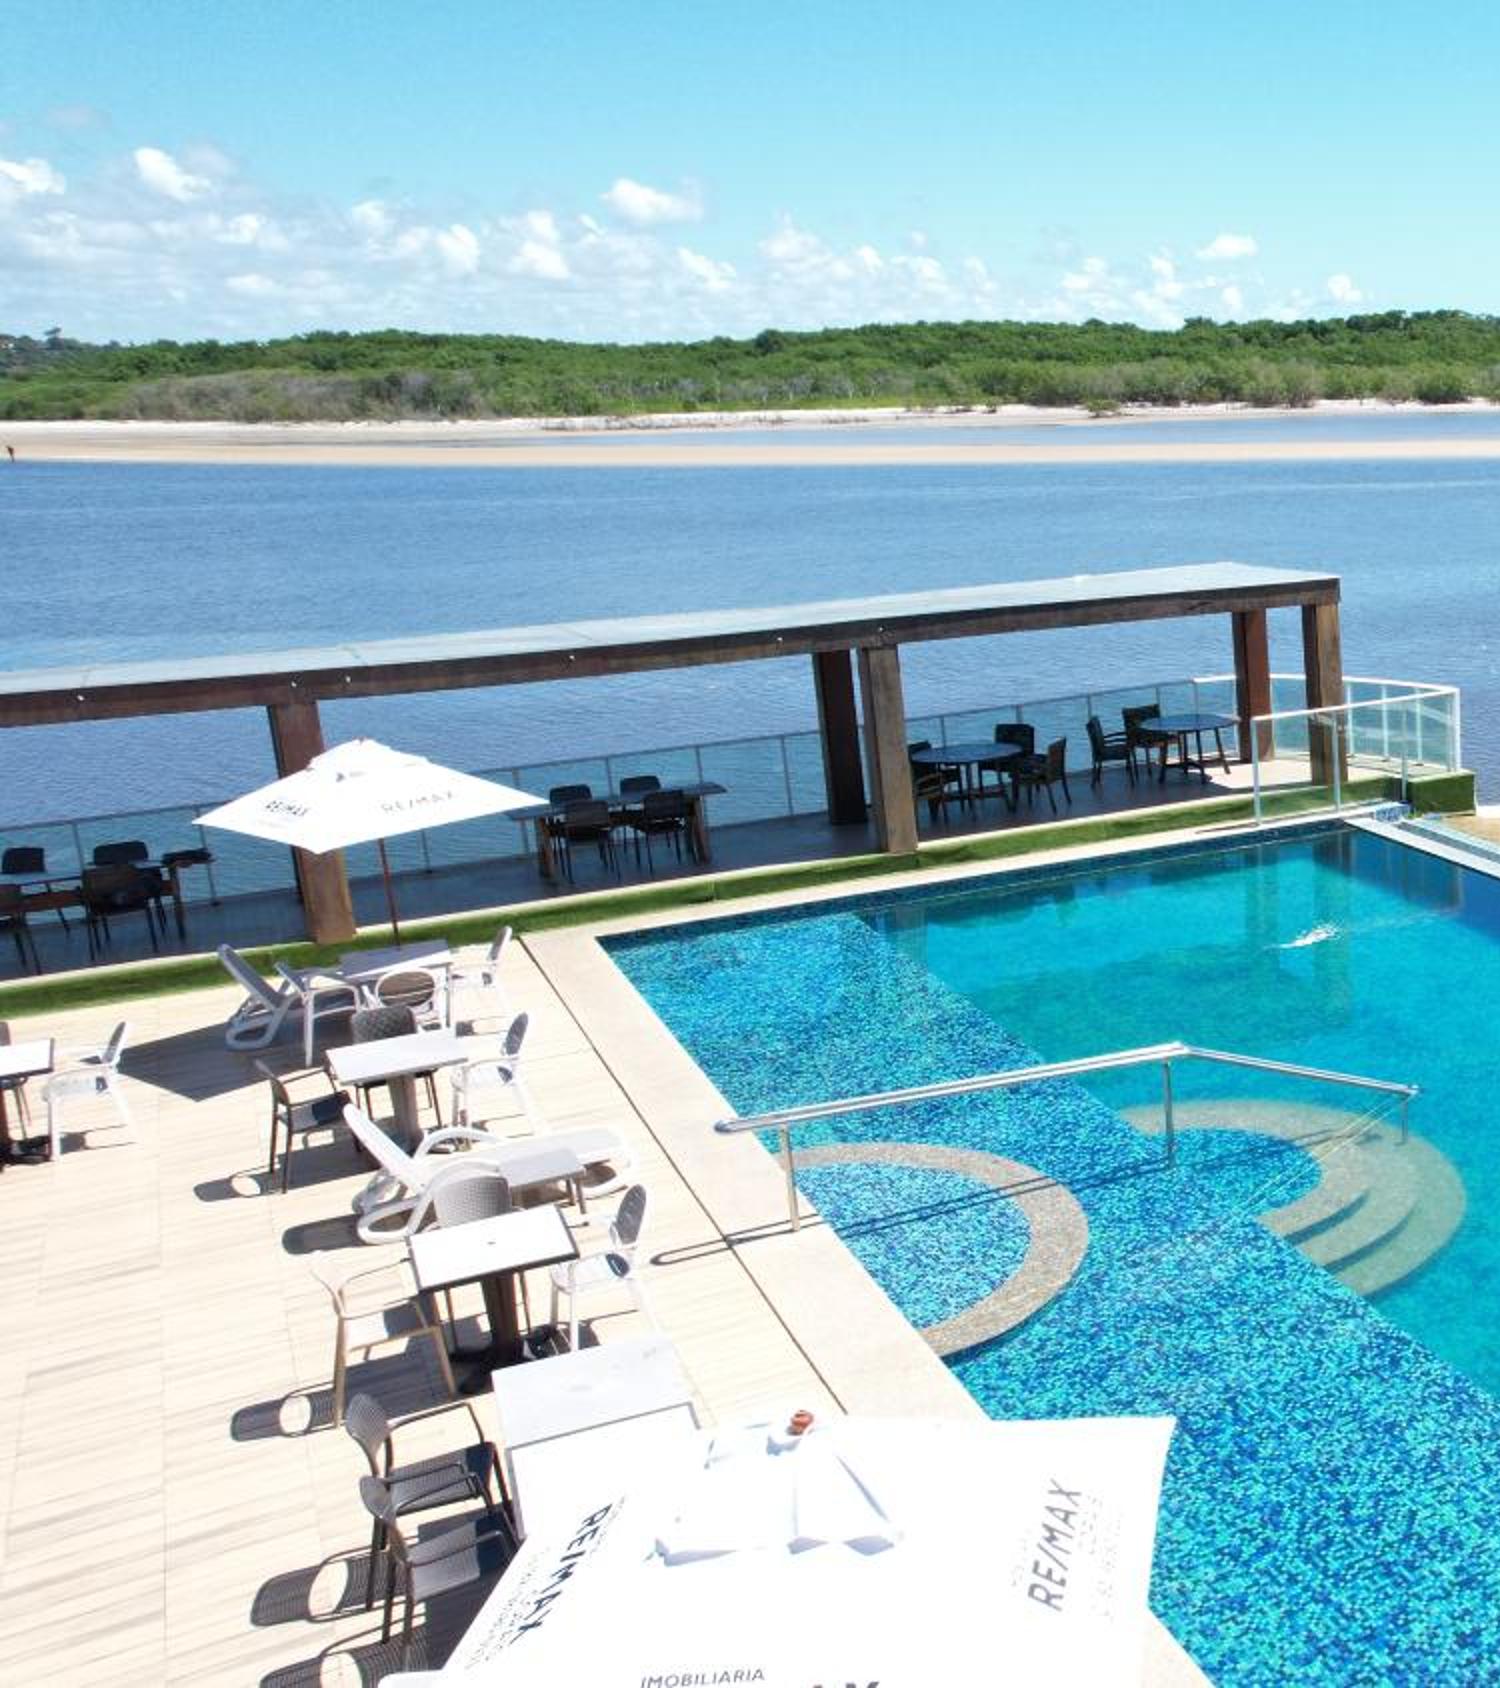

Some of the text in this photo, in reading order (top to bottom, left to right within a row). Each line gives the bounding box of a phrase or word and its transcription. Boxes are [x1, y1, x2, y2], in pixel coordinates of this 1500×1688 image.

[507, 1502, 613, 1647] RE/MAX
[1027, 1477, 1083, 1612] RE/MAX
[639, 1667, 766, 1688] IMOBILIARIA
